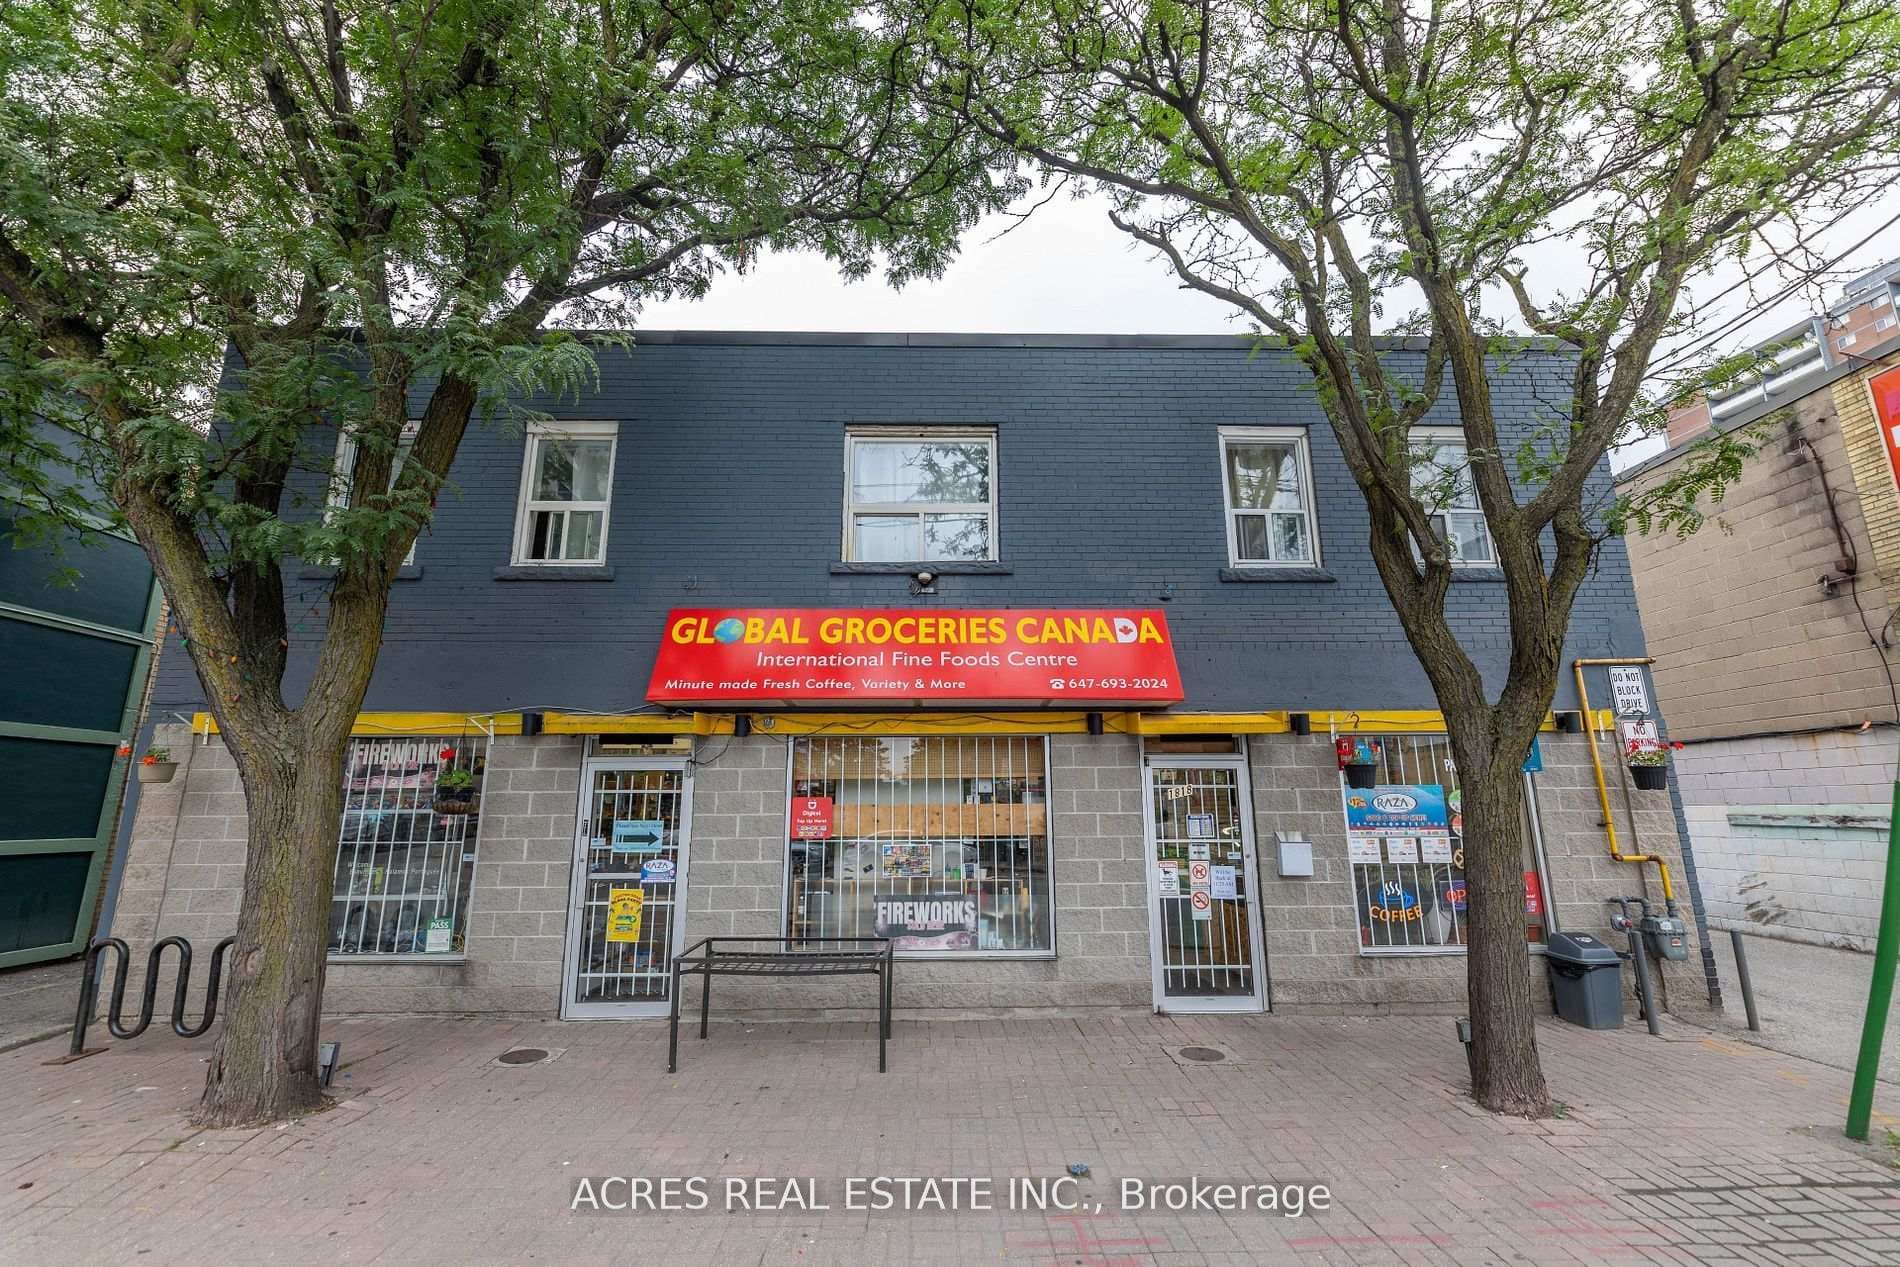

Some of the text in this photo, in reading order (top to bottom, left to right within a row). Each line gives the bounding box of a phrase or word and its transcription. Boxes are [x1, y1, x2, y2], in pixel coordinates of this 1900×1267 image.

[671, 617, 1164, 644] GLOBAL GROCERIES CANADA
[757, 651, 1078, 667] International Fine Foods Centre
[1613, 672, 1640, 682] DO NOT
[665, 678, 966, 691] Minute made Fresh Coffee, Variety & More
[1068, 678, 1169, 689] 647-693-2024
[1617, 686, 1641, 696] BLOCK
[1621, 699, 1643, 709] DRIVE
[1632, 725, 1646, 736] NO
[1377, 797, 1409, 809] RAZA
[877, 901, 976, 925] FIREWORKS
[1369, 904, 1423, 922] COFFEE
[431, 921, 449, 930] PASS
